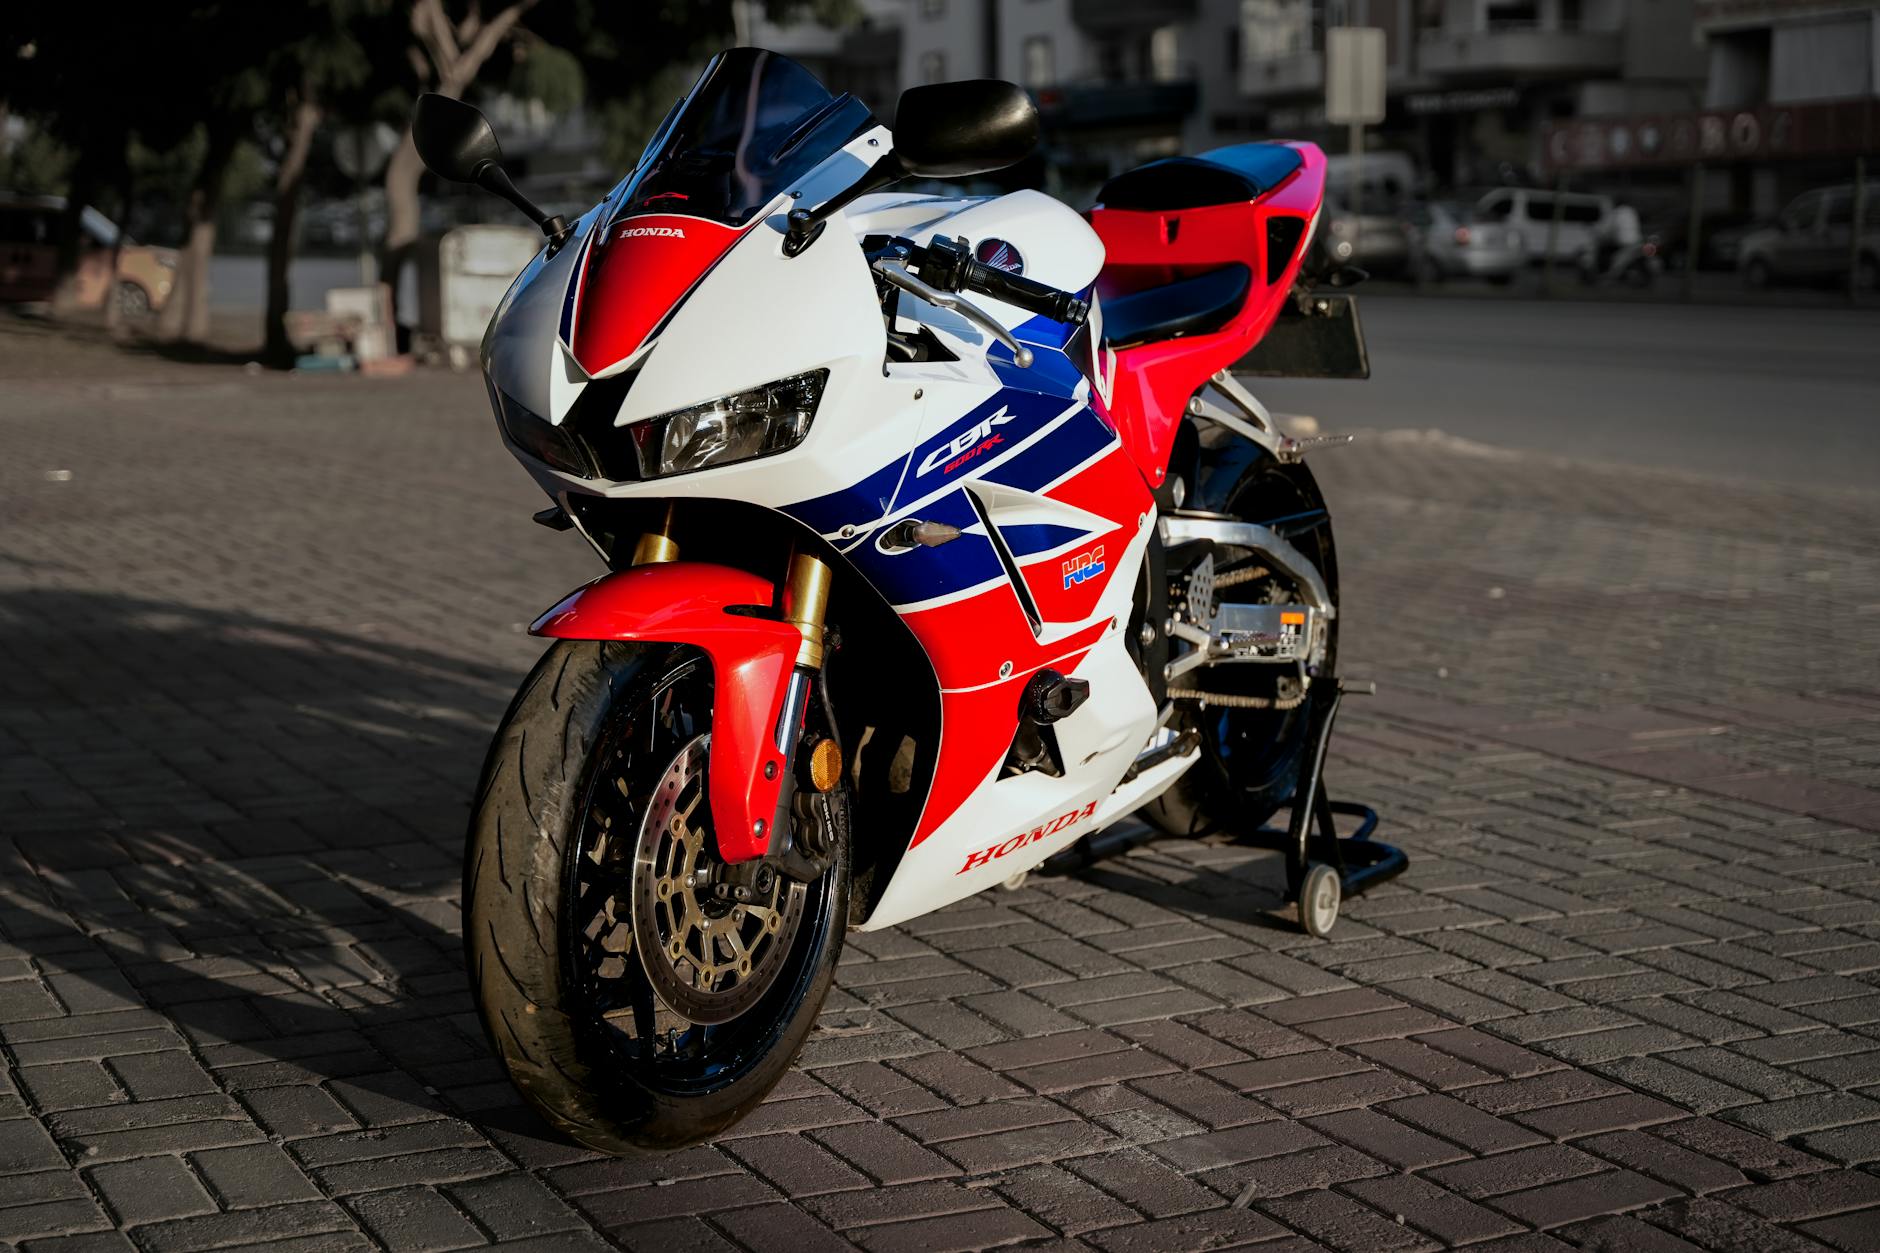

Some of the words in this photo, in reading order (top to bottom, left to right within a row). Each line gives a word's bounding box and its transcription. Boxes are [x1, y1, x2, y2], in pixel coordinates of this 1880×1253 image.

[619, 227, 686, 239] HONDA
[916, 404, 1017, 478] CBR
[943, 433, 1005, 475] 600RR
[1062, 544, 1105, 591] HRC
[955, 800, 1098, 876] HONDA
